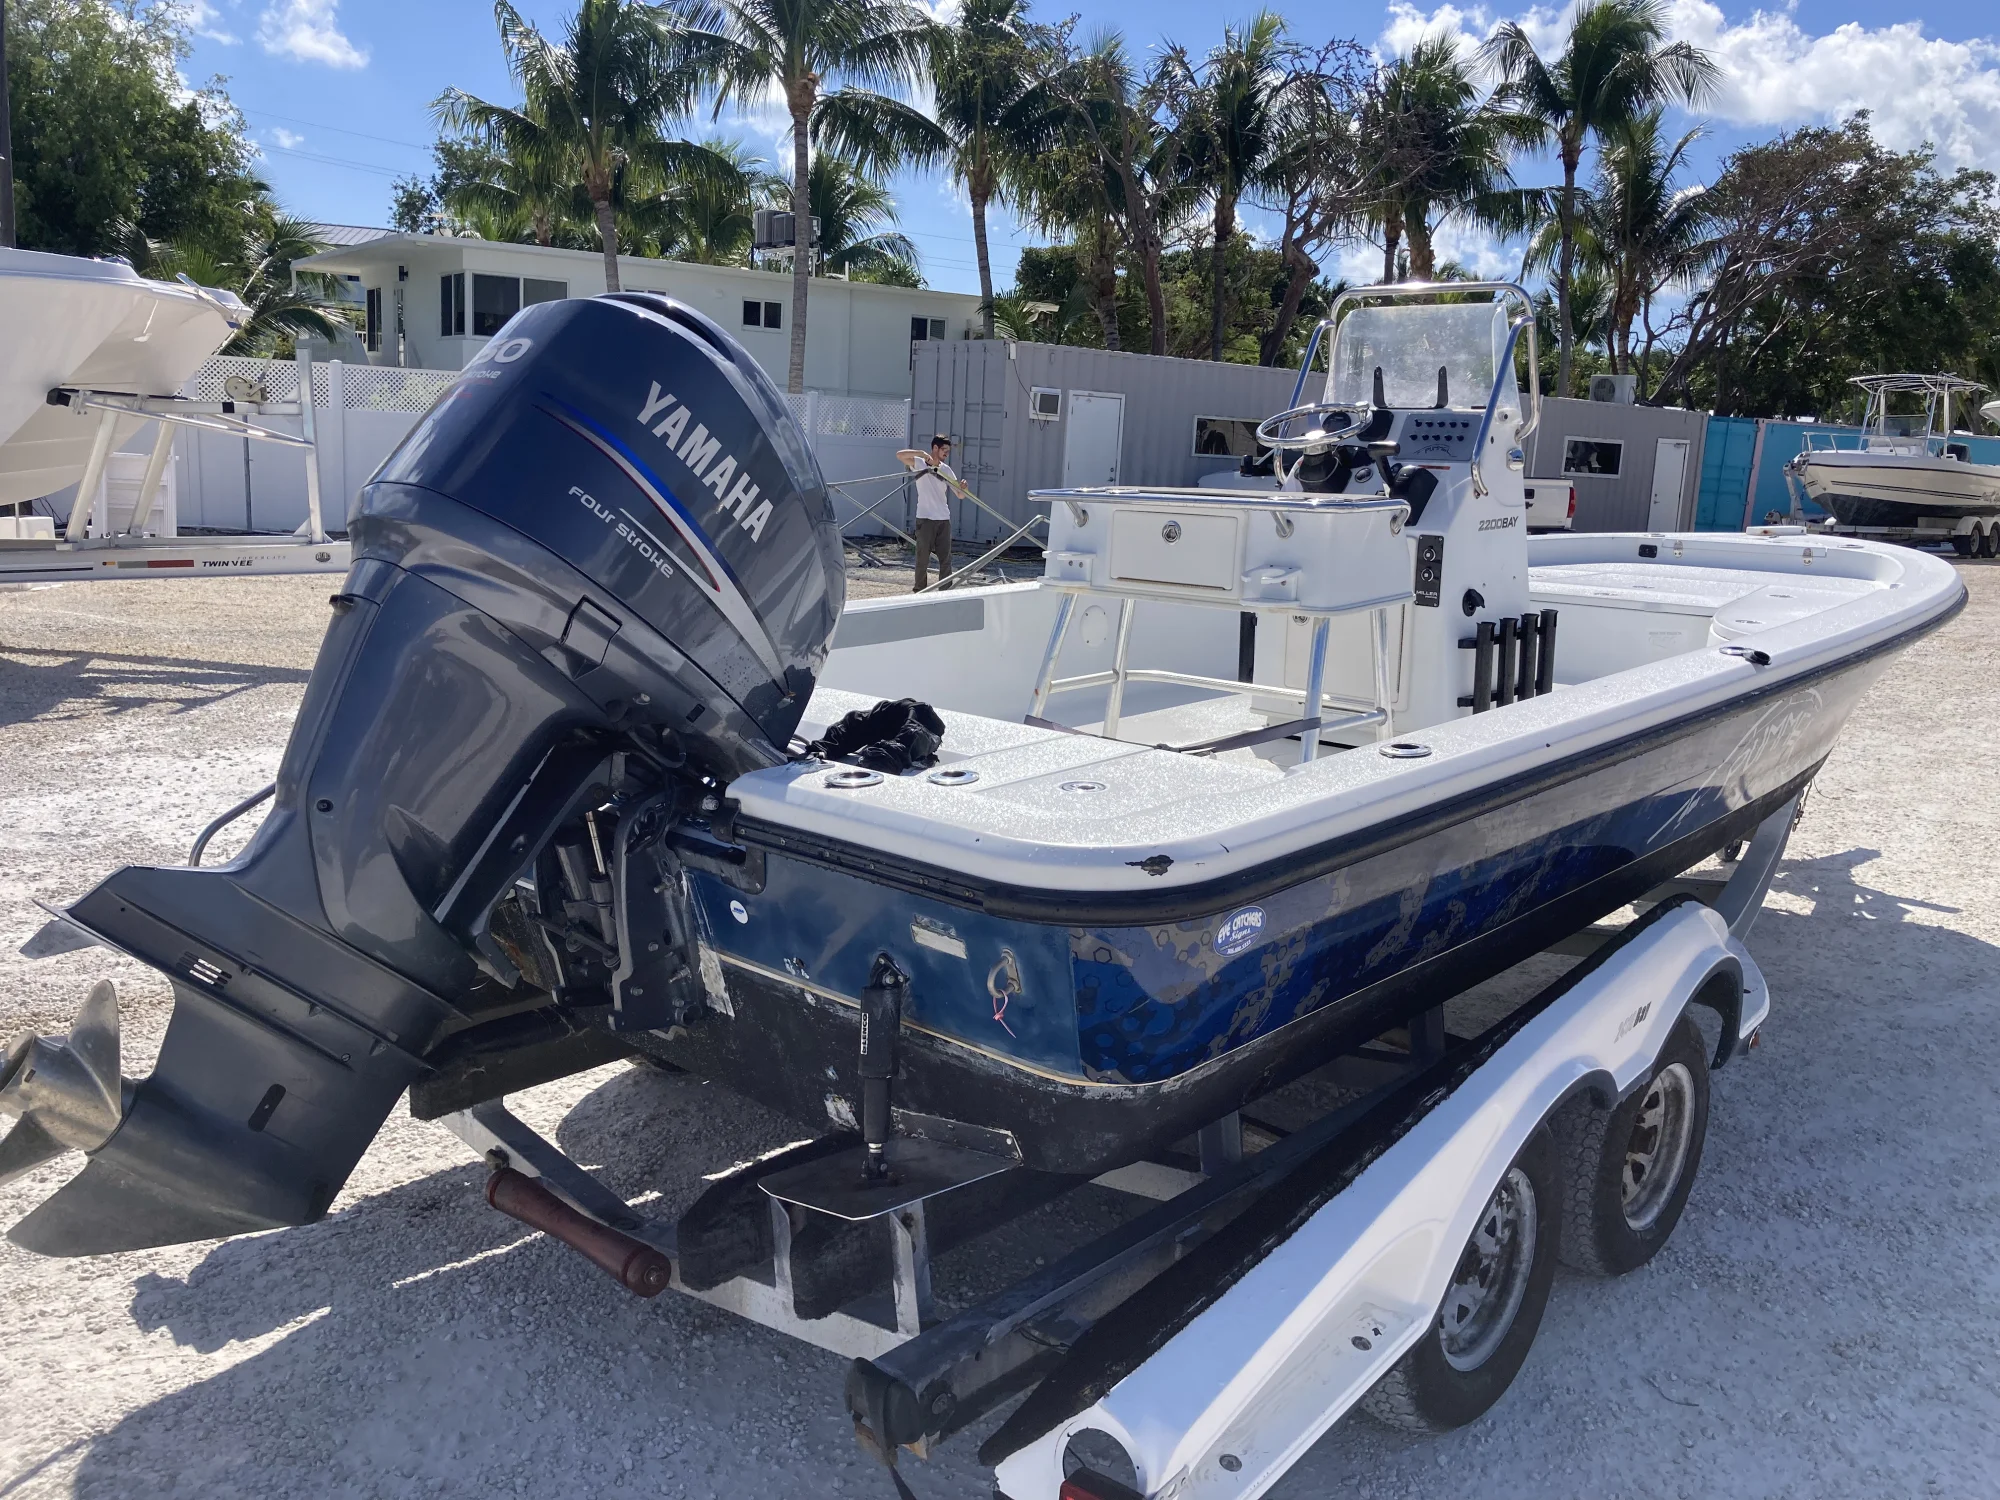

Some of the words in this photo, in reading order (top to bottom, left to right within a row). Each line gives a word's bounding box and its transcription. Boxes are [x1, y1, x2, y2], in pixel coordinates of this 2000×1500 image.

[636, 380, 774, 543] YAMAHA
[1478, 516, 1519, 531] 2200BAY
[231, 559, 253, 567] VEE
[1218, 921, 1231, 944] EYE
[1233, 911, 1262, 931] CATCHERS
[1230, 928, 1251, 941] Signs
